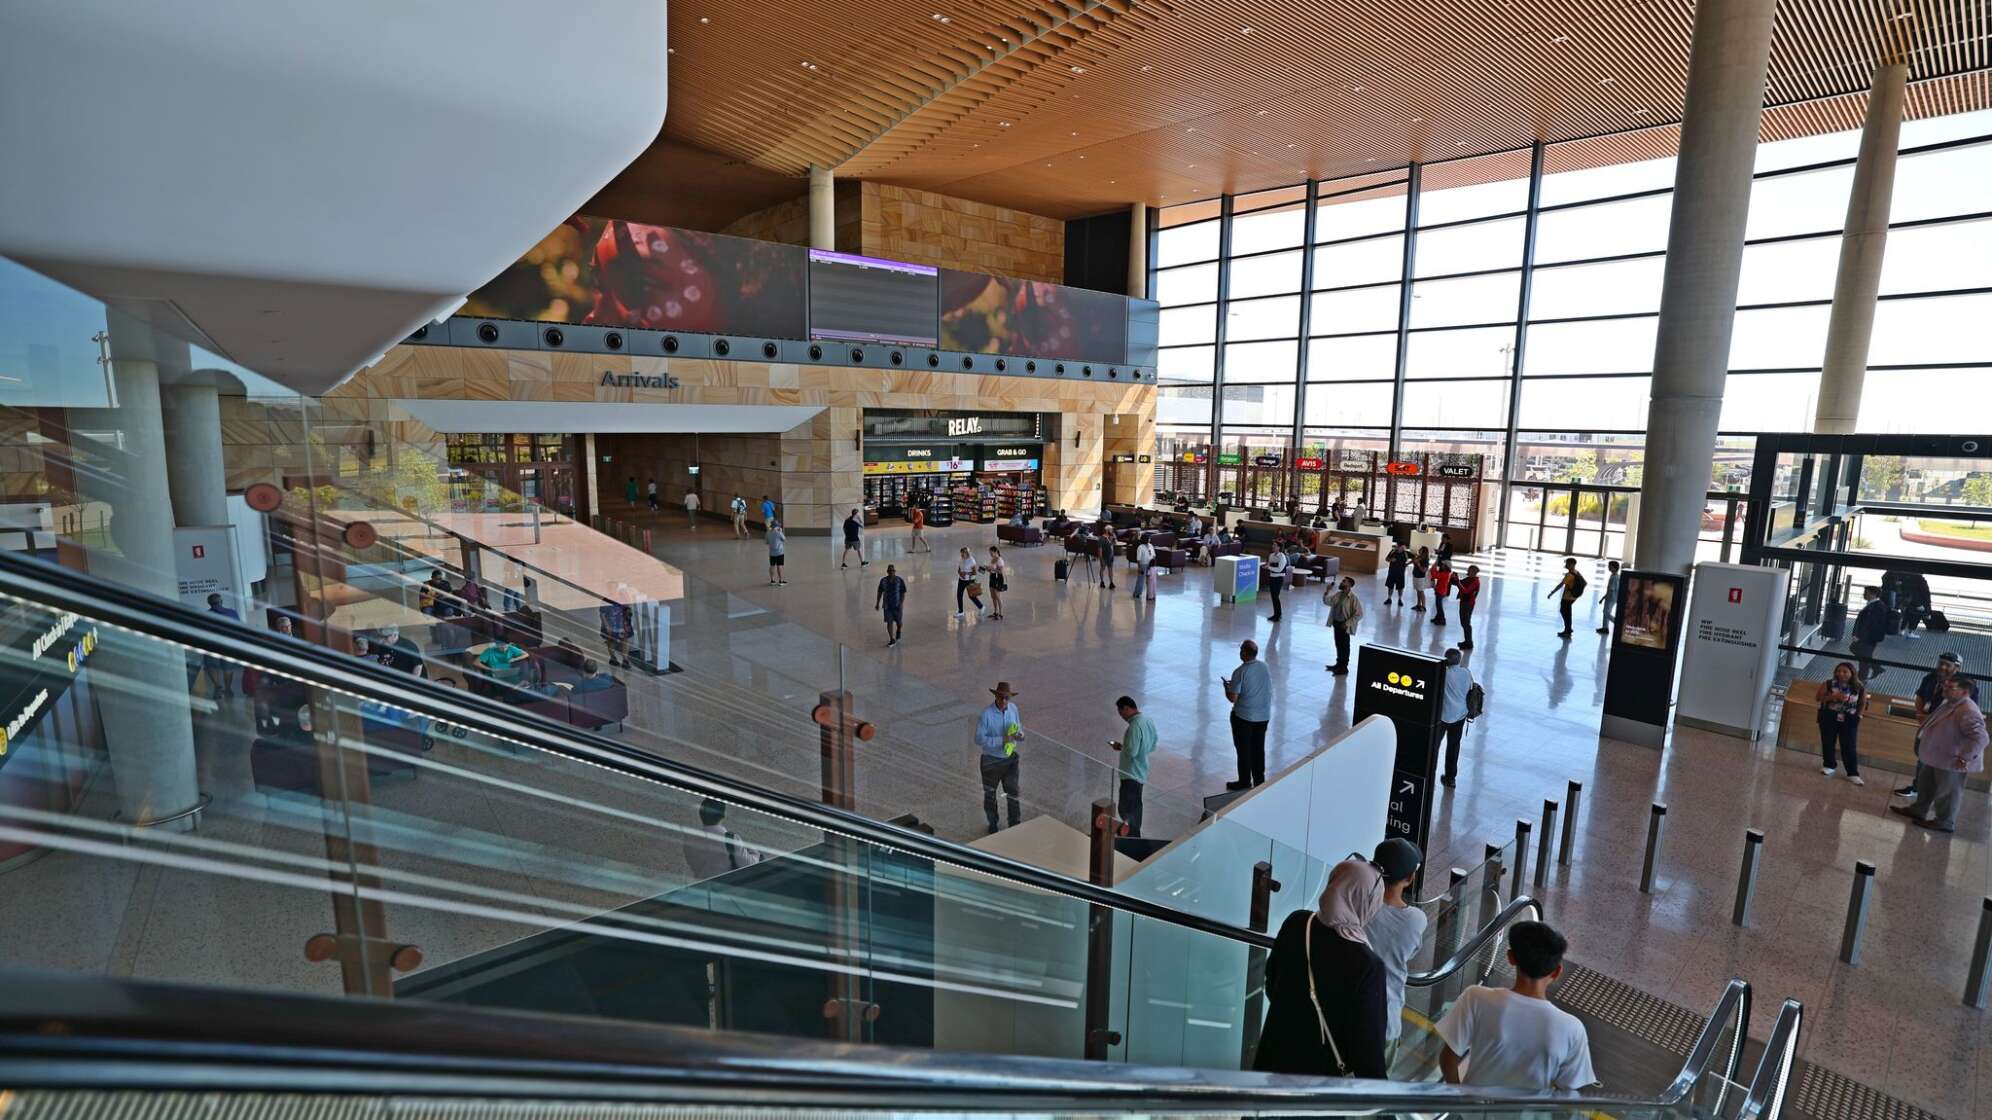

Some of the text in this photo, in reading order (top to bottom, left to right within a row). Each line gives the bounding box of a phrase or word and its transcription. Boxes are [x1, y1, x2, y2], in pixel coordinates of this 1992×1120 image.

[601, 371, 679, 388] Arrivals
[948, 417, 979, 436] RELAY
[907, 449, 931, 457] DRINKS
[1443, 467, 1469, 476] VALET
[1371, 681, 1424, 700] All Departures
